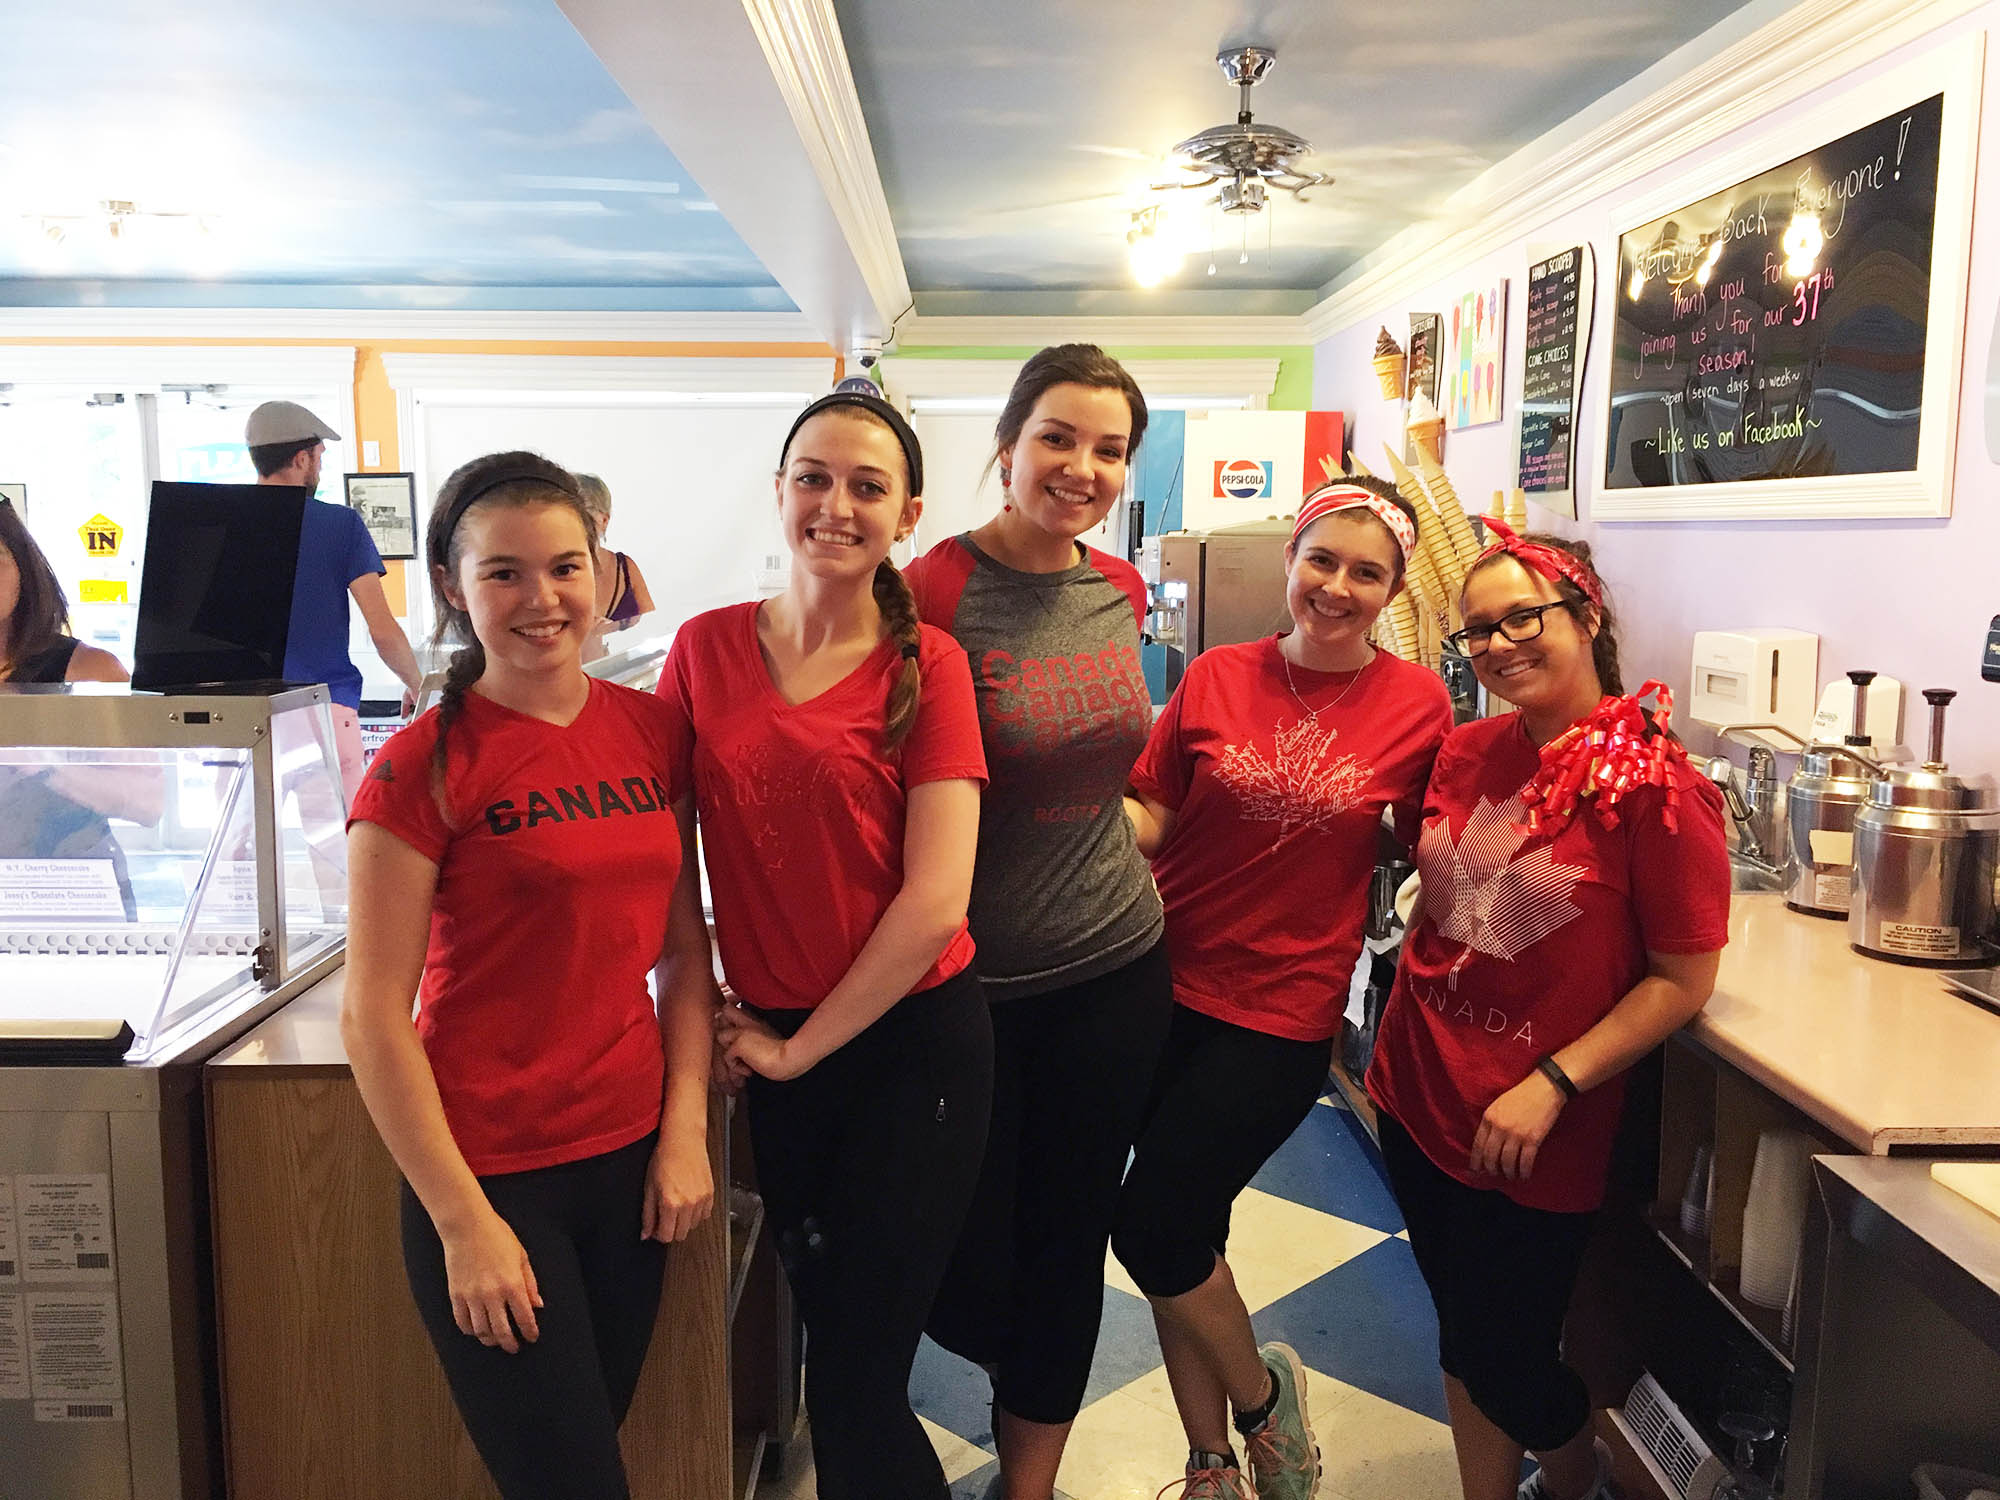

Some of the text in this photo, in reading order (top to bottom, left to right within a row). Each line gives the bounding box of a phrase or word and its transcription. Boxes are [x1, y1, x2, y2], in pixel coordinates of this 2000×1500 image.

[1632, 232, 1705, 283] Welcome
[1719, 193, 1769, 244] Back
[1548, 251, 1574, 276] SCOOPED
[1670, 252, 1785, 330] Thank you for
[1634, 267, 1835, 379] joining us for our 37th
[1528, 344, 1569, 368] CONE CHOICES
[1699, 334, 1755, 376] season!
[1692, 384, 1719, 399] seven
[1727, 376, 1749, 403] days
[1759, 377, 1765, 390] a
[1693, 434, 1709, 449] us
[1718, 430, 1734, 447] on
[88, 532, 116, 550] IN
[981, 640, 1141, 692] Canada
[1895, 925, 1942, 934] CAUTION
